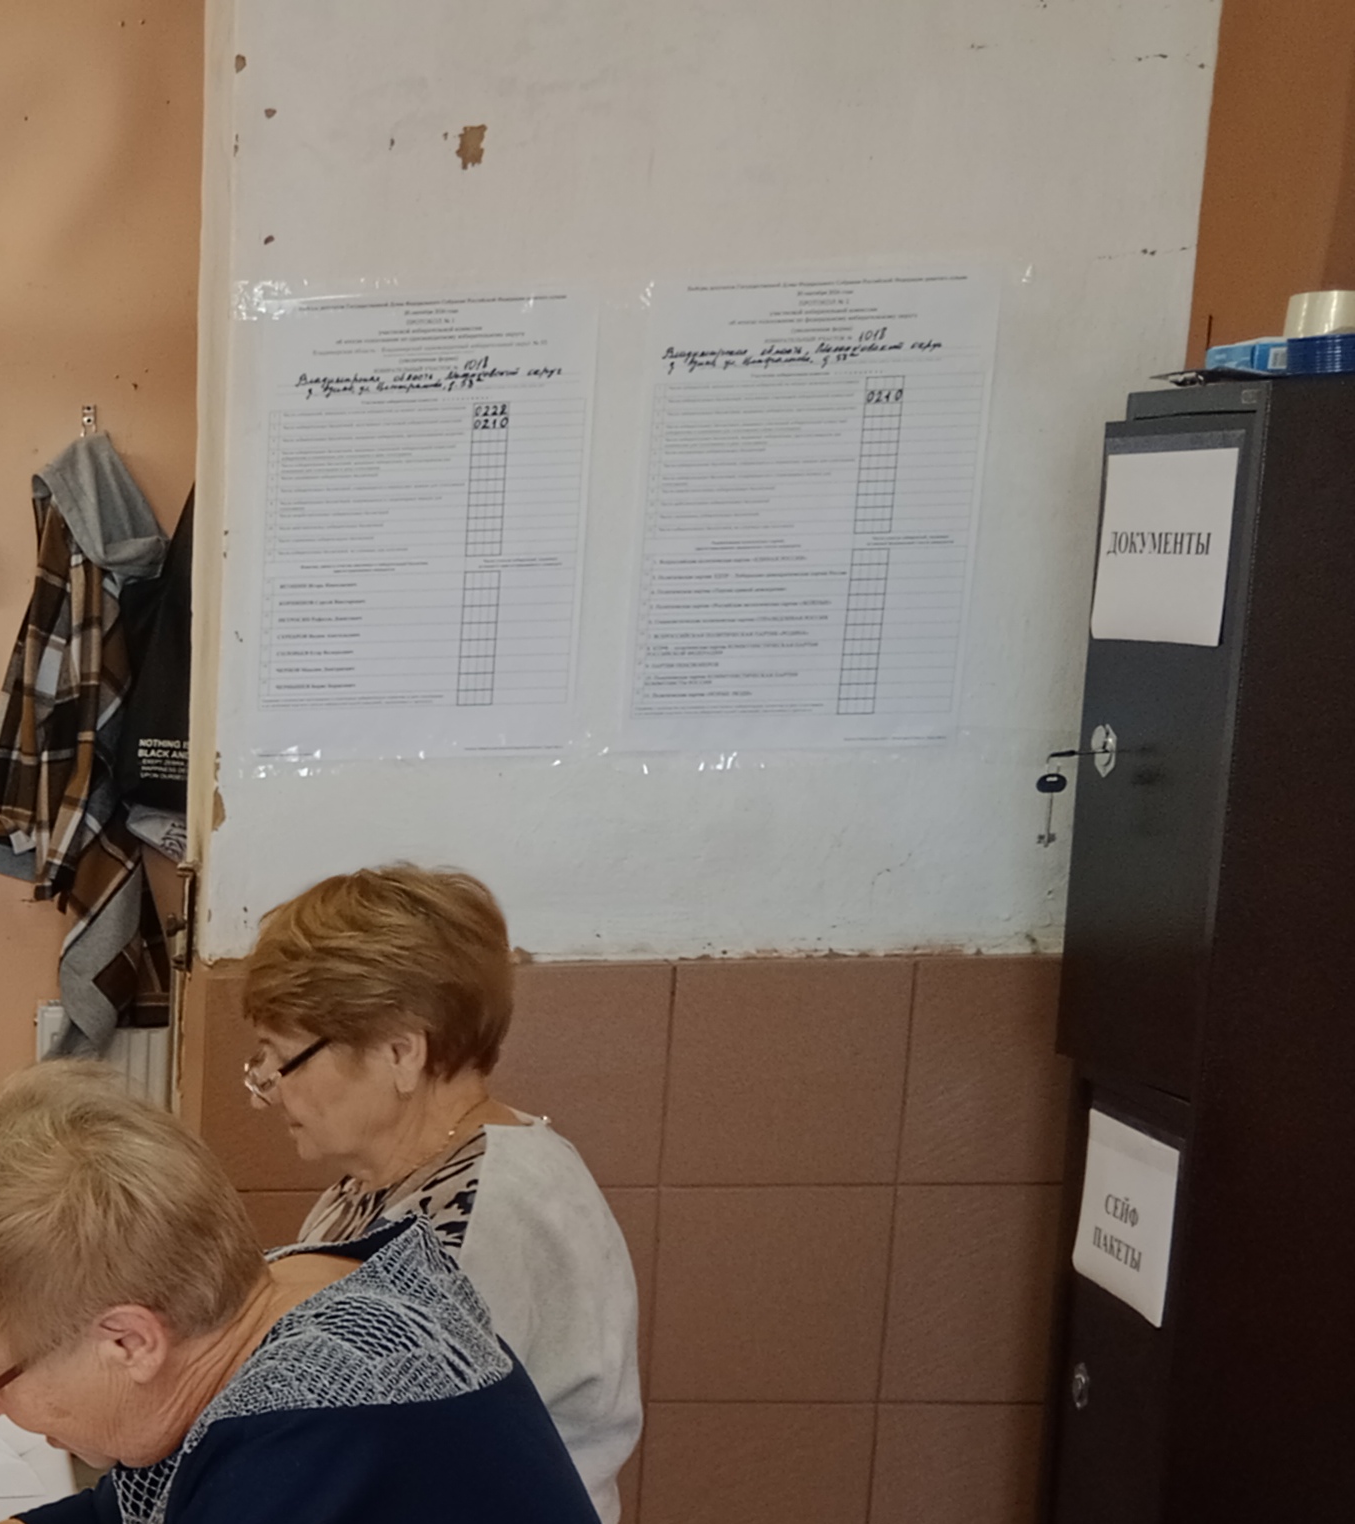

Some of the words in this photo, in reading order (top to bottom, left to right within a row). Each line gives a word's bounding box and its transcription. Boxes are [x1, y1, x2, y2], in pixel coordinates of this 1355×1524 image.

[865, 388, 904, 403] 0210
[472, 418, 509, 431] 0210
[1106, 531, 1212, 557] ДОКУМЕНТЫ
[138, 738, 181, 749] NOTHING
[137, 749, 170, 758] BLACK
[1104, 1193, 1139, 1228] СЕЙФ
[1092, 1226, 1143, 1273] ПАКЕТЫ
